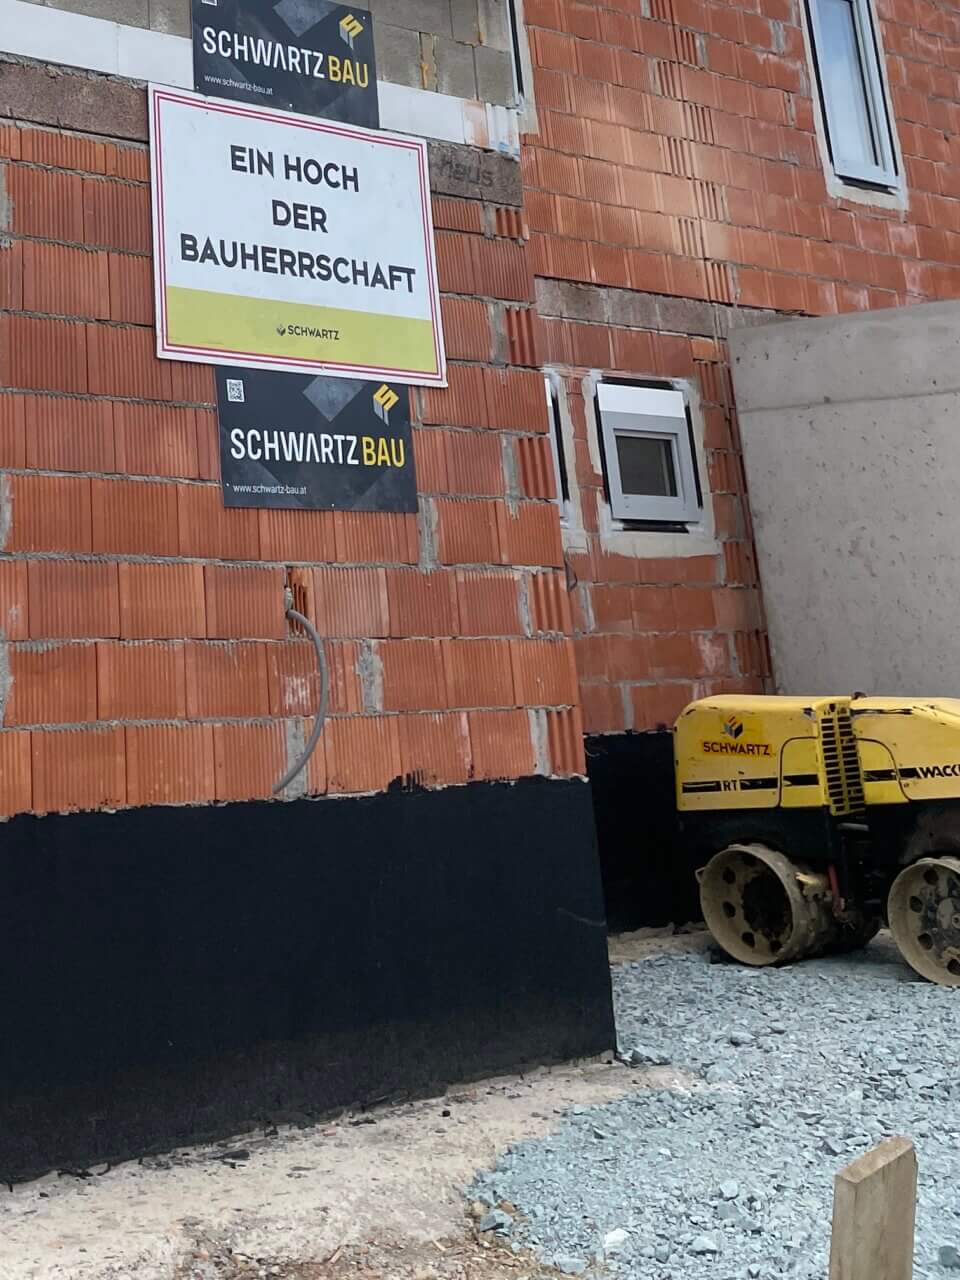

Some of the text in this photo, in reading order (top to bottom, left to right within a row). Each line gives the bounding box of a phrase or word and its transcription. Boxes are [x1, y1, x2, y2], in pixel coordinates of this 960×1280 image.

[204, 74, 273, 96] www.schwartz-bau.at
[230, 144, 360, 192] EIN HOCH
[272, 199, 328, 233] DER
[180, 233, 416, 293] BAUHERRSCHAFT
[287, 325, 340, 340] SCHWARTZ
[233, 483, 307, 495] www.schwartz-bau.at
[703, 741, 770, 756] SCHWARTZ
[919, 764, 960, 778] WACK
